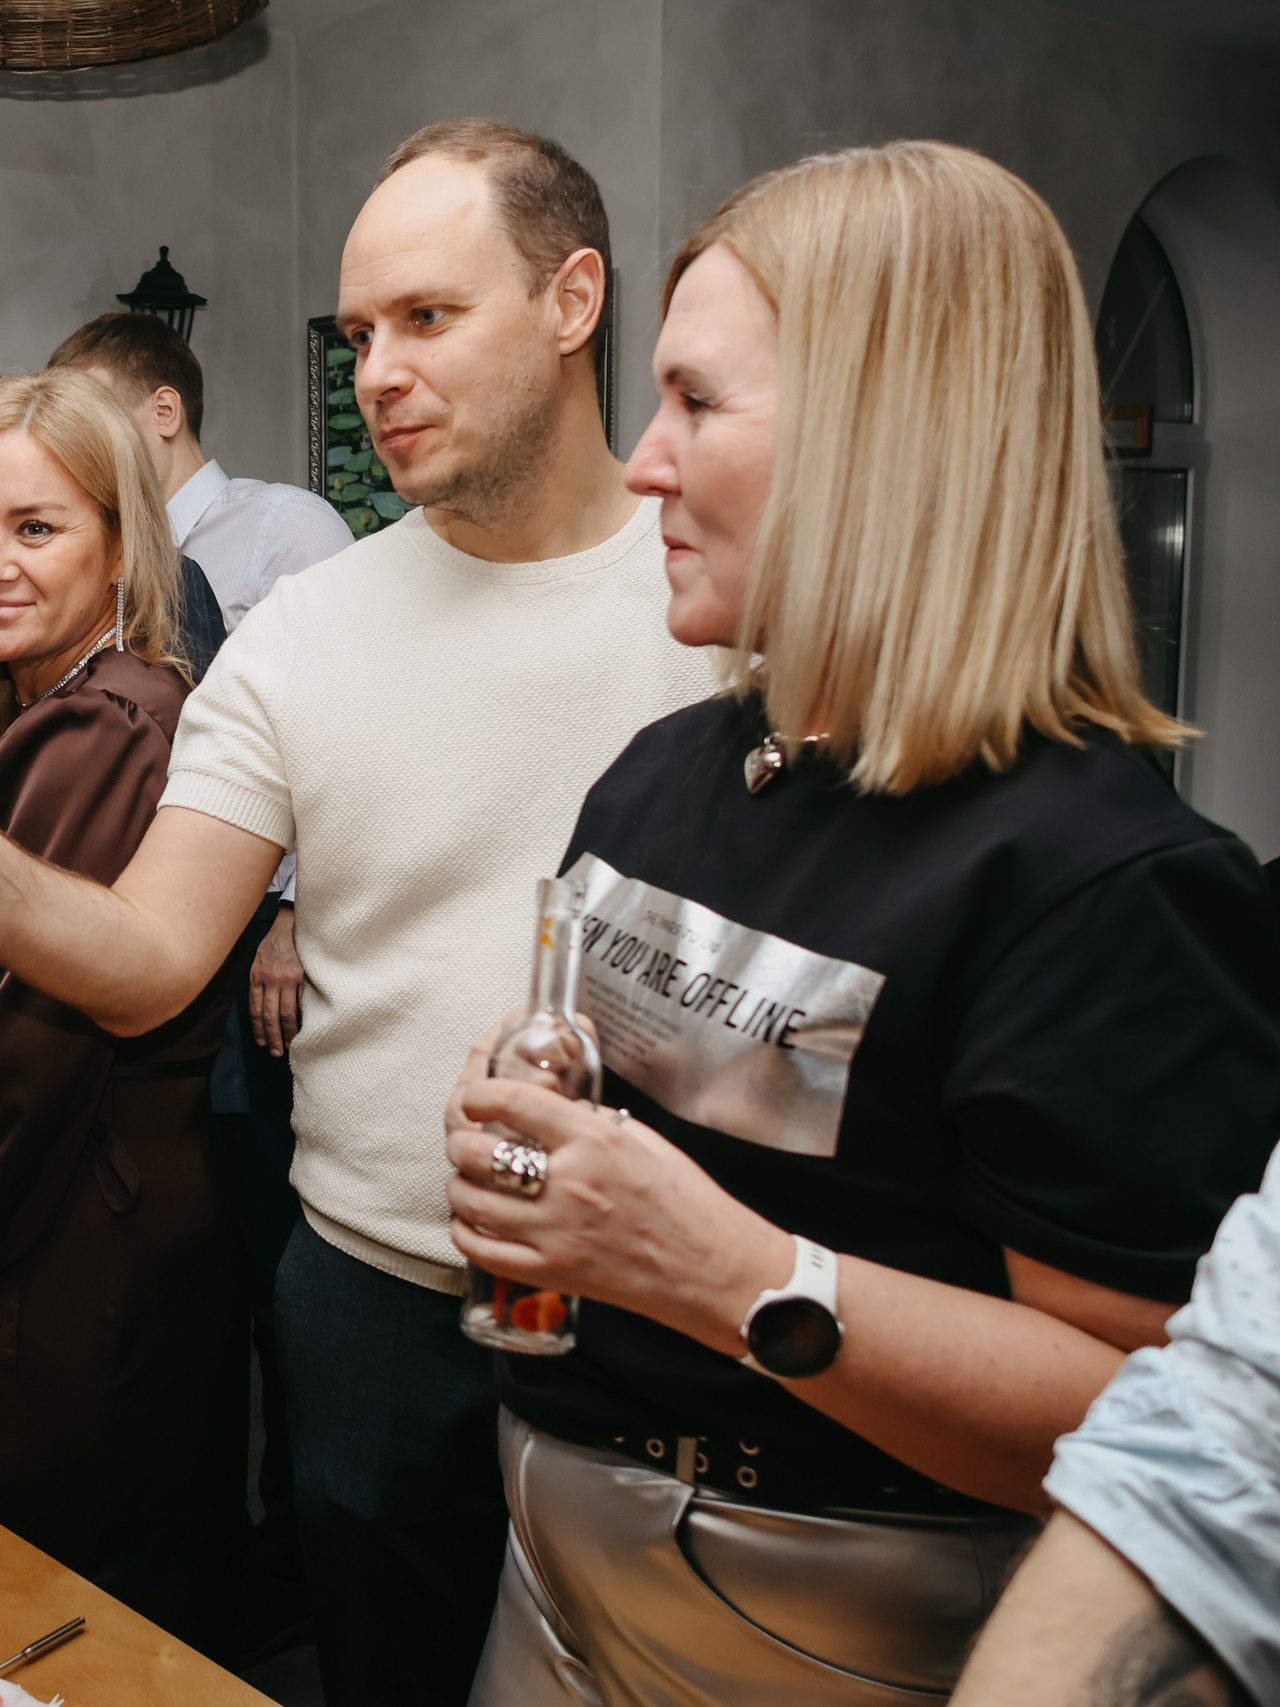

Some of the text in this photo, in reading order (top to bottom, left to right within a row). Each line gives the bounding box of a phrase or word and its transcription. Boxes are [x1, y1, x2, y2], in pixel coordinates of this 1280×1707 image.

[581, 914, 610, 954] EN
[600, 929, 651, 975] YOU
[637, 949, 687, 998] ARE
[680, 972, 807, 1050] OFFLINE
